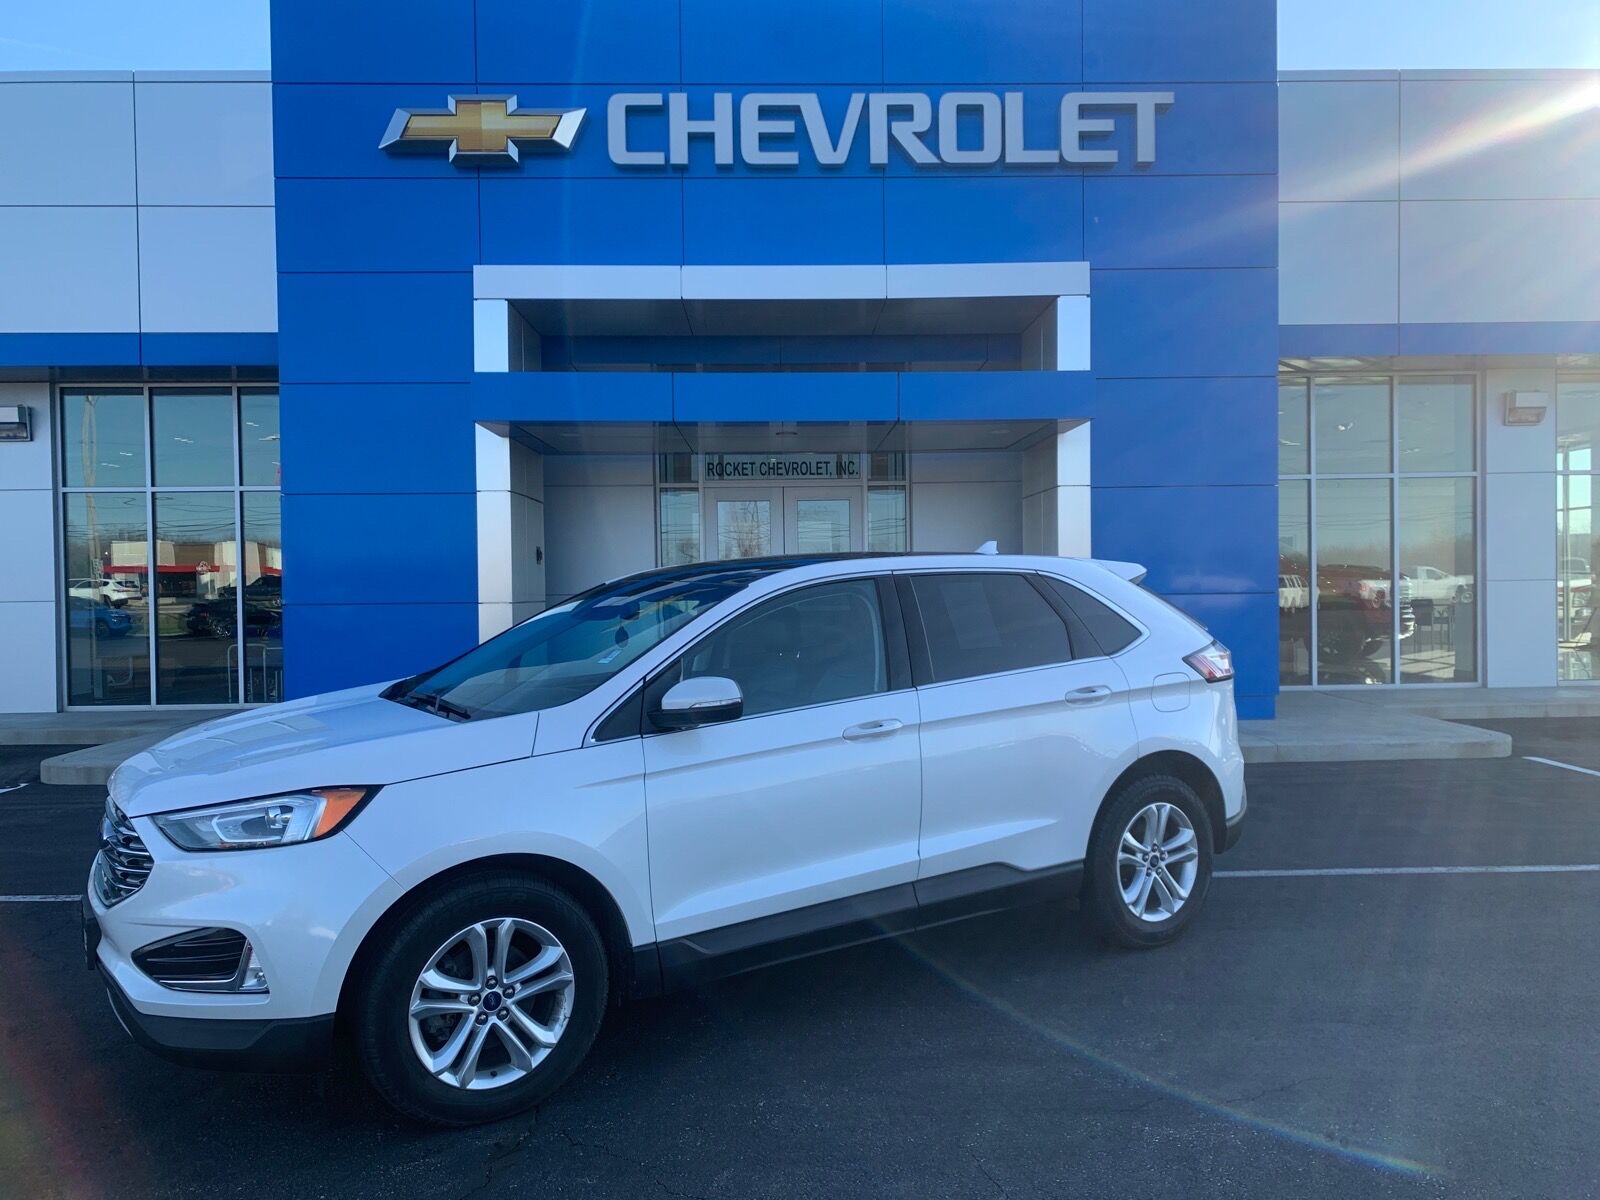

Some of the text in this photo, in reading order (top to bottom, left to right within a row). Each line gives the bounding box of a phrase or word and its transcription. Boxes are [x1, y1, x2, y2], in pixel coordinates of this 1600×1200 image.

[607, 91, 1174, 166] CHEVROLET
[706, 460, 859, 477] ROCKET CHEVROLET, INC.
